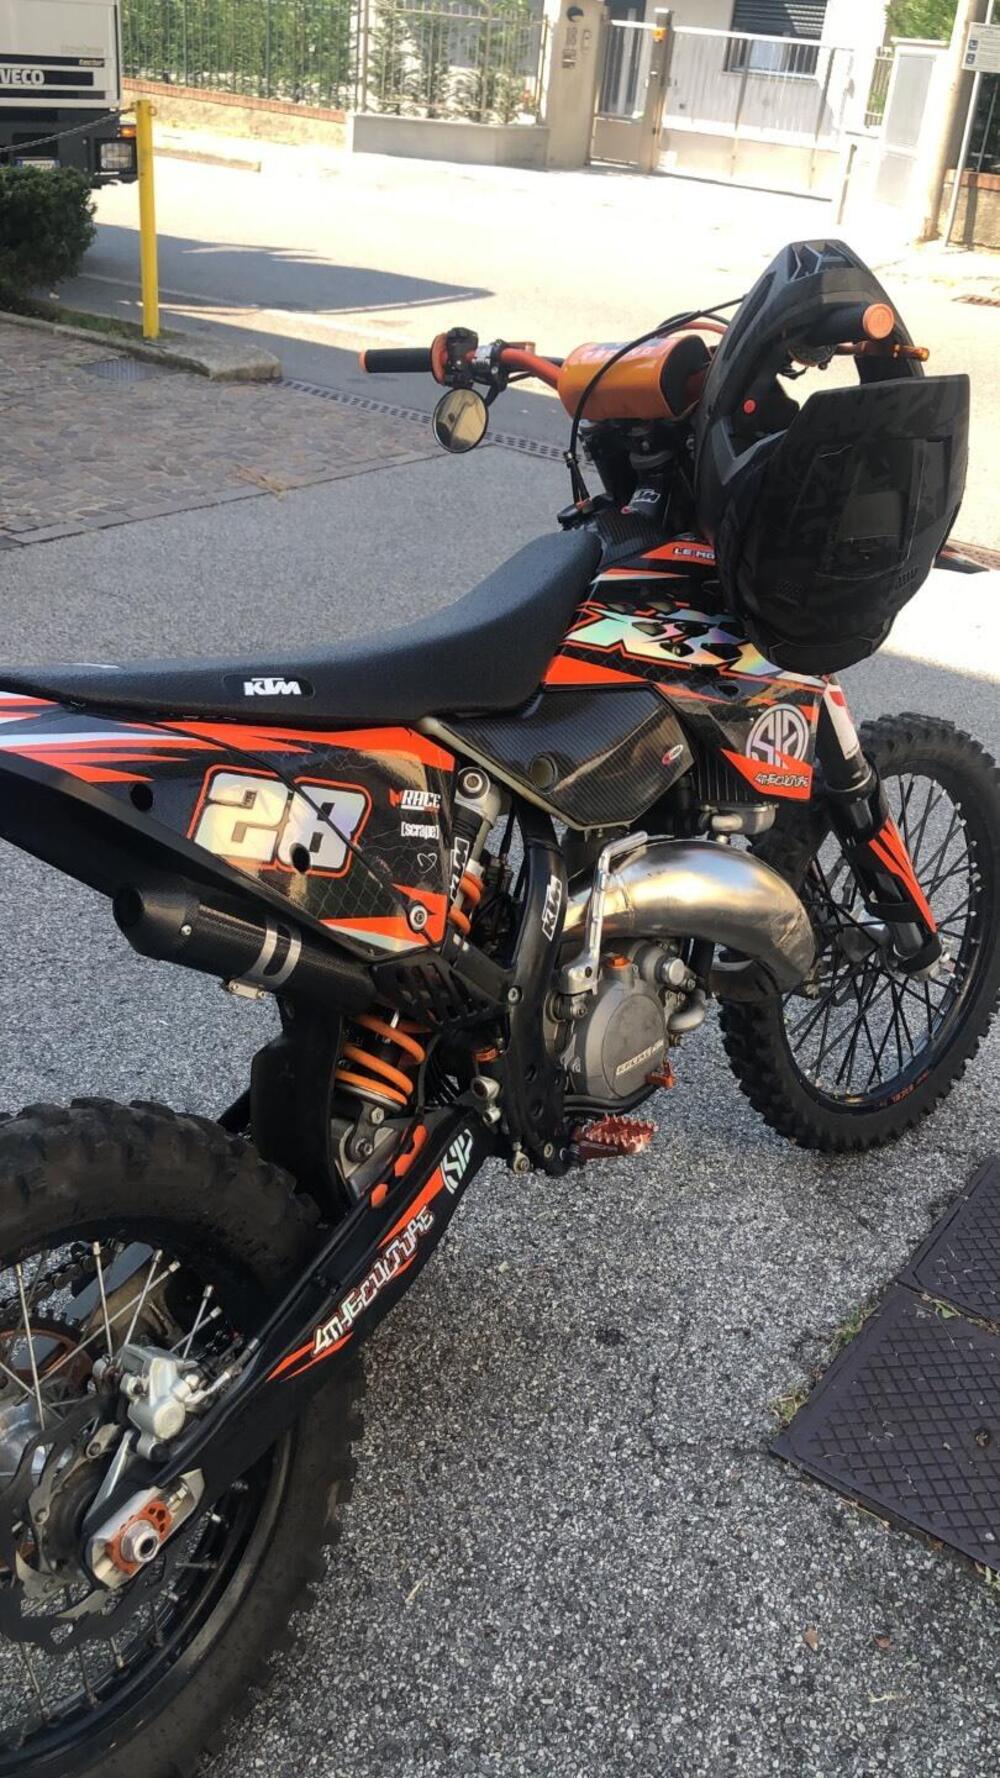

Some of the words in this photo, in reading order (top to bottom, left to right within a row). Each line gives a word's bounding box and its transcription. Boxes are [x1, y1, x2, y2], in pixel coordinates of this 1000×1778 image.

[0, 68, 45, 85] VECO
[244, 677, 301, 696] KTM
[191, 770, 369, 872] 28
